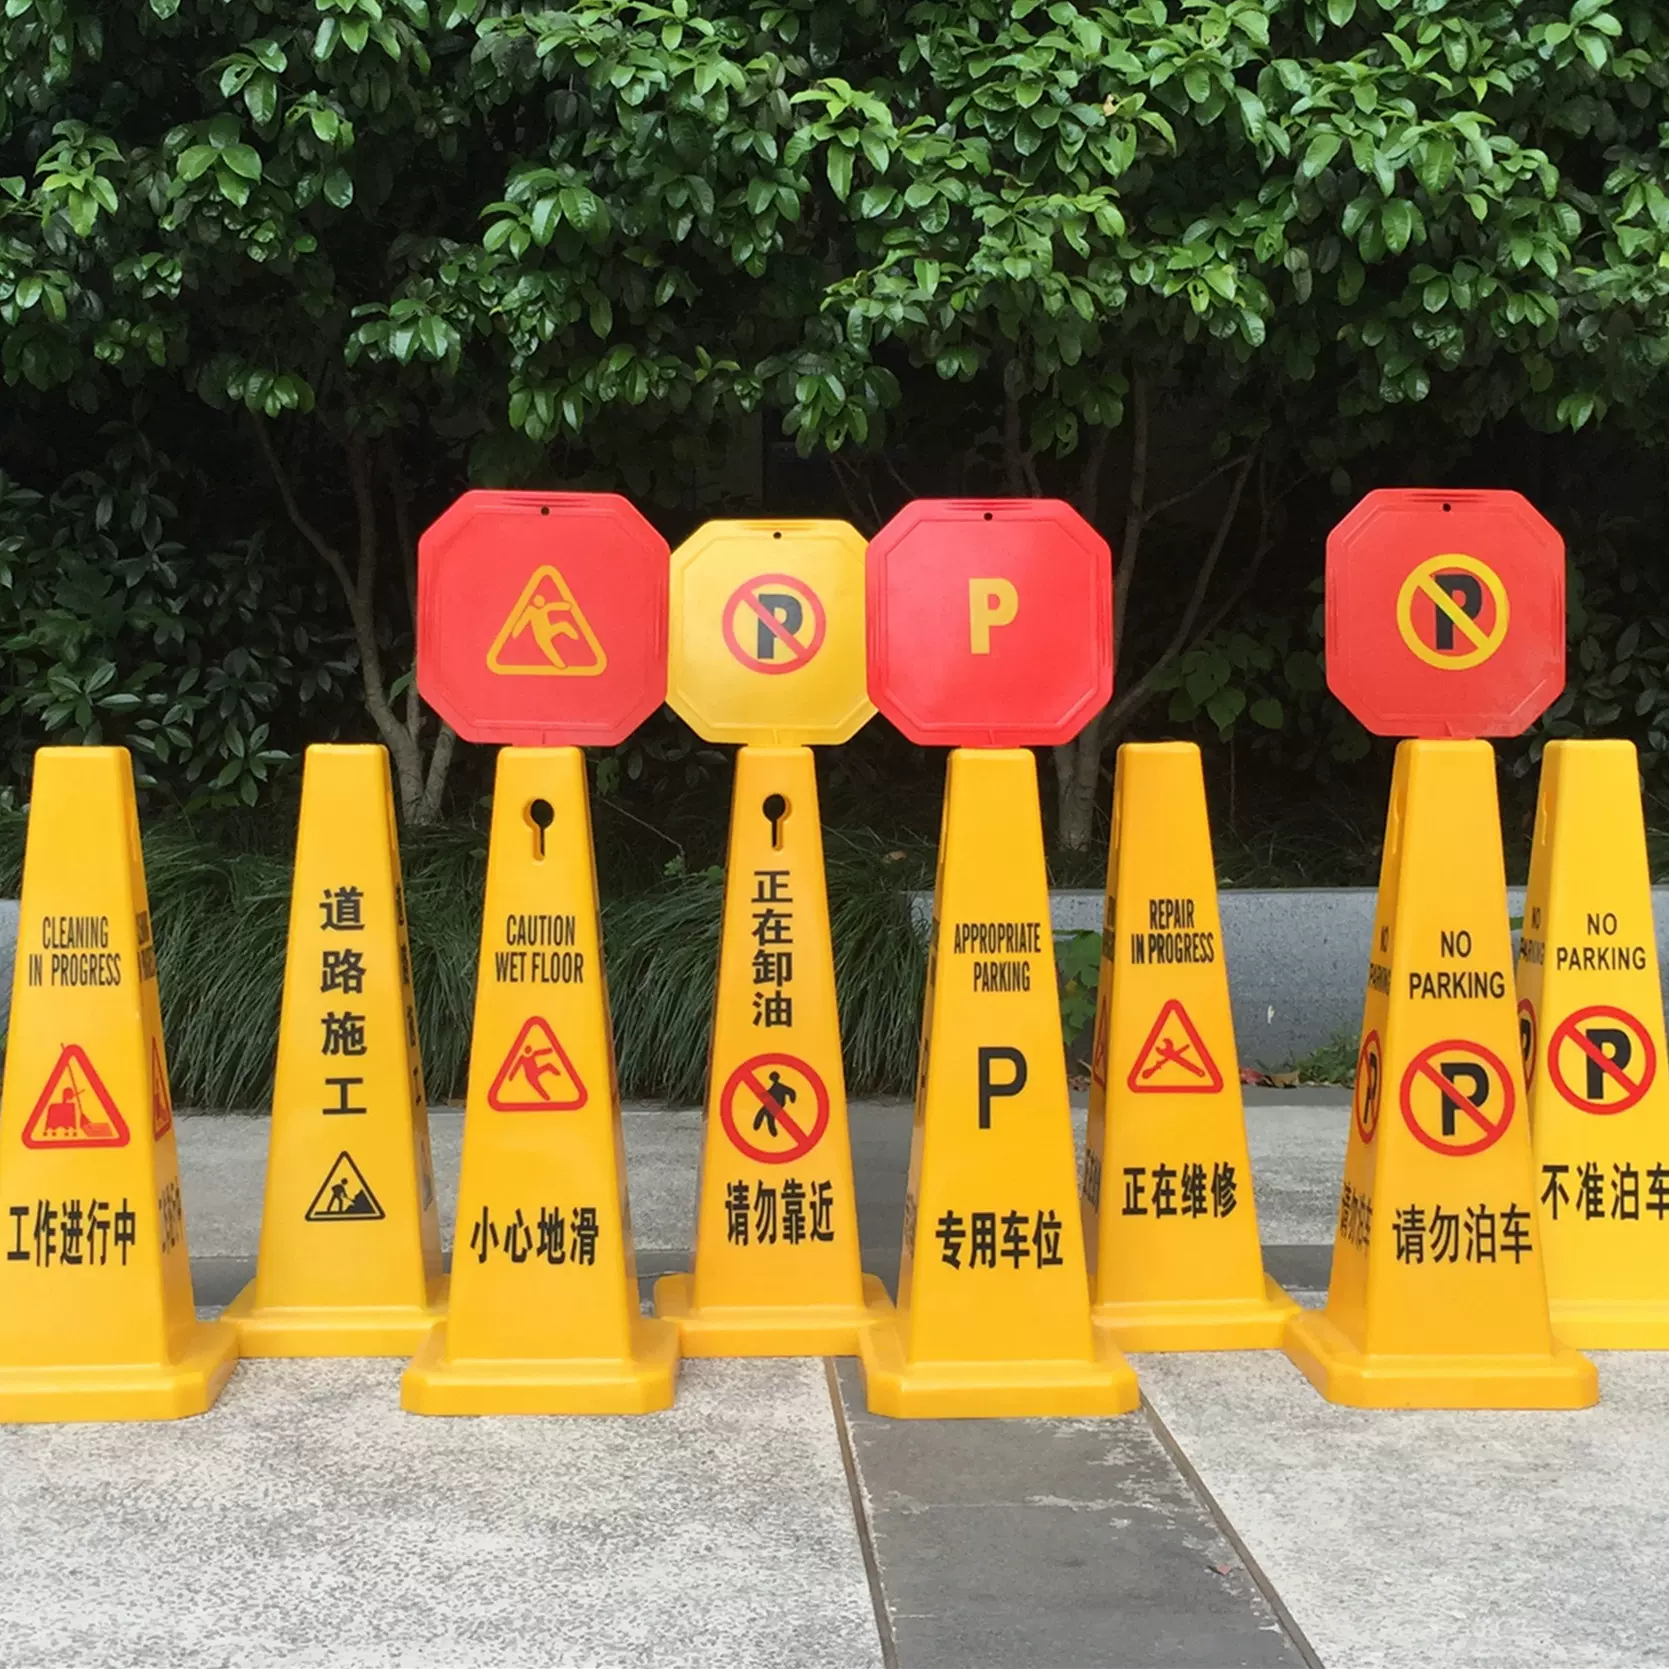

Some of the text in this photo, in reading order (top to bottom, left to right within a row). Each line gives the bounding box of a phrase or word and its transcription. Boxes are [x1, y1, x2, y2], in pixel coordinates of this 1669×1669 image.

[757, 594, 803, 660] P
[969, 578, 1019, 655] P
[1435, 573, 1483, 651] P
[42, 915, 109, 949] CLEANING
[506, 914, 576, 946] CAUTION
[954, 922, 1041, 954] APPROPRIATE
[1148, 898, 1195, 930] REPAIR
[1440, 930, 1472, 958] NO
[1587, 912, 1618, 936] NO
[29, 952, 121, 987] IN PROGRESS
[495, 951, 584, 984] WET FLOOR
[751, 870, 794, 1028] 正在卸油
[973, 960, 1031, 992] PARKING
[1131, 931, 1215, 965] IN PROGRESS
[1556, 946, 1647, 971] PARKING
[318, 885, 367, 1115] 道路施工
[1409, 971, 1506, 1000] PARKING
[978, 1046, 1028, 1129] P
[1585, 1028, 1632, 1100] P
[1440, 1062, 1490, 1137] P
[724, 1177, 836, 1247] 请勿靠近
[1121, 1161, 1238, 1220] 正在维修
[1540, 1161, 1669, 1222] 不准泊车
[7, 1197, 137, 1268] 工作进行中
[469, 1205, 600, 1267] 小心地滑
[935, 1209, 1064, 1270] 专用车位
[1392, 1202, 1534, 1265] 请勿泊车
